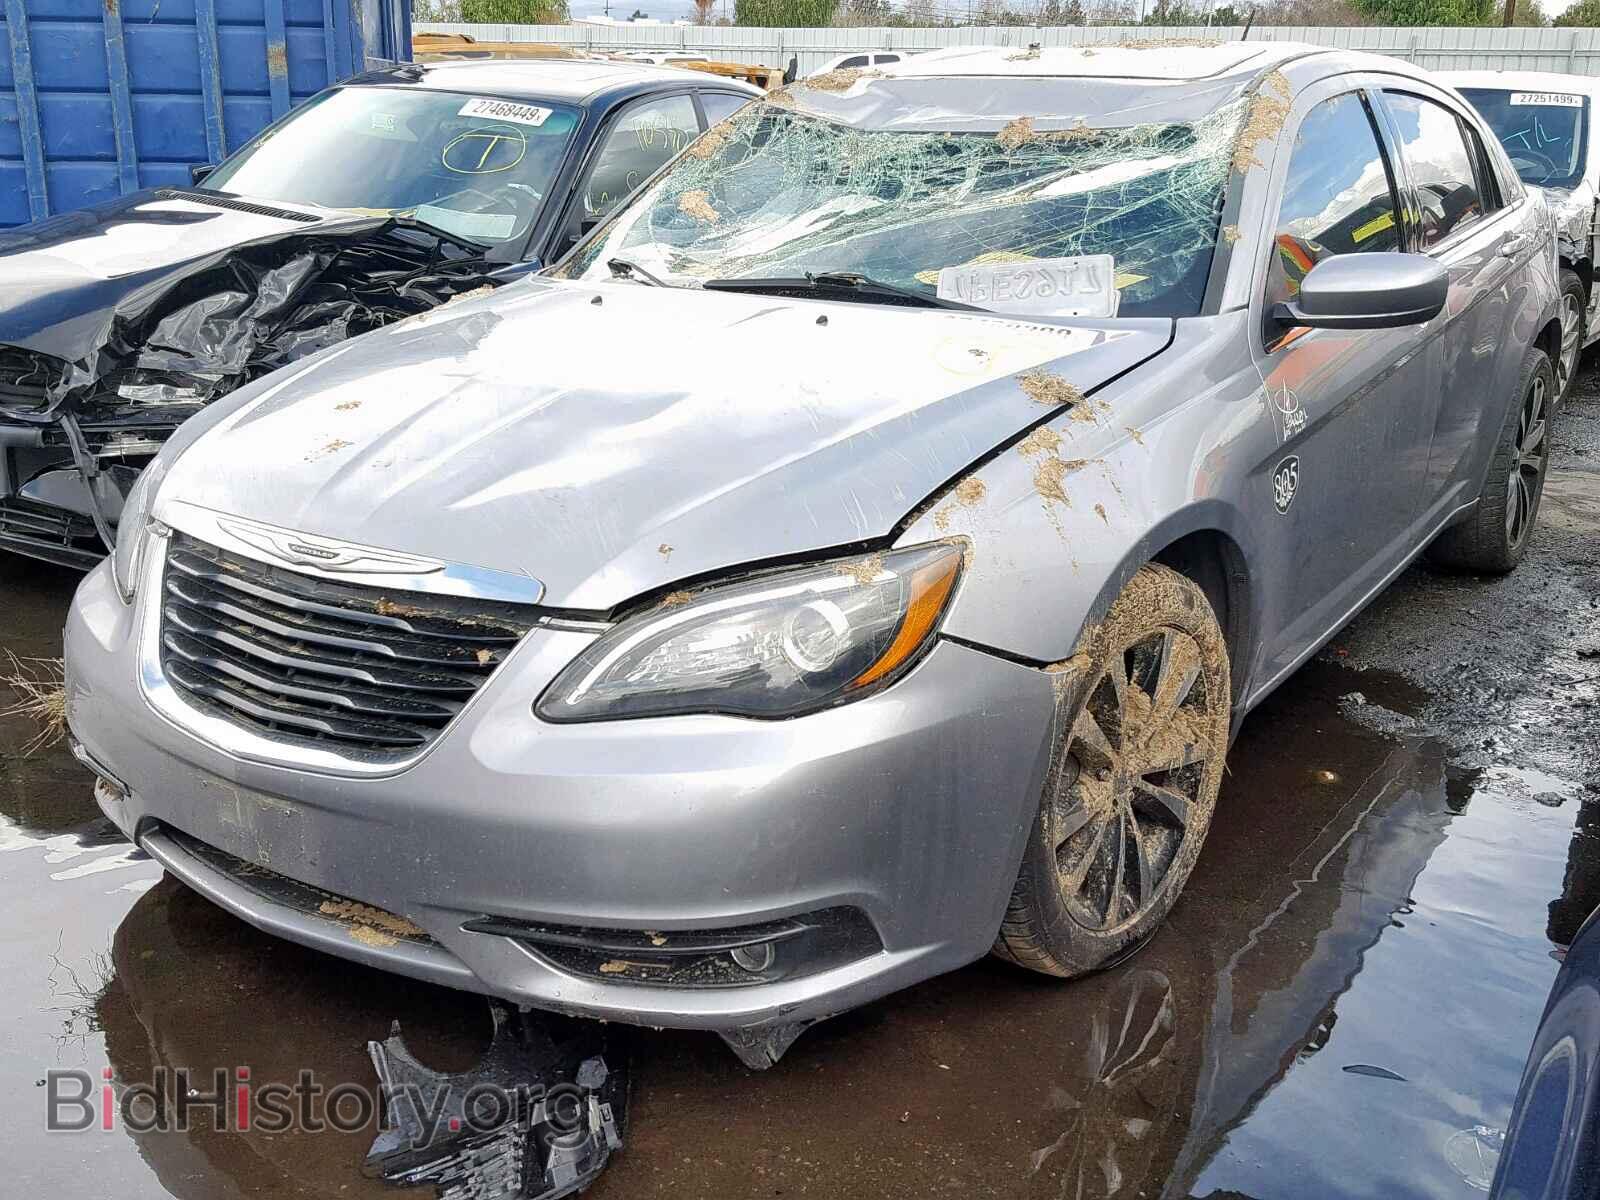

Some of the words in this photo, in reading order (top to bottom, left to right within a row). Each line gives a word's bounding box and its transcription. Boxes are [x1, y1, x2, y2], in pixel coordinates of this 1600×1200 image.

[1519, 94, 1573, 105] 27251499
[463, 134, 528, 169] T
[1274, 461, 1297, 503] 805
